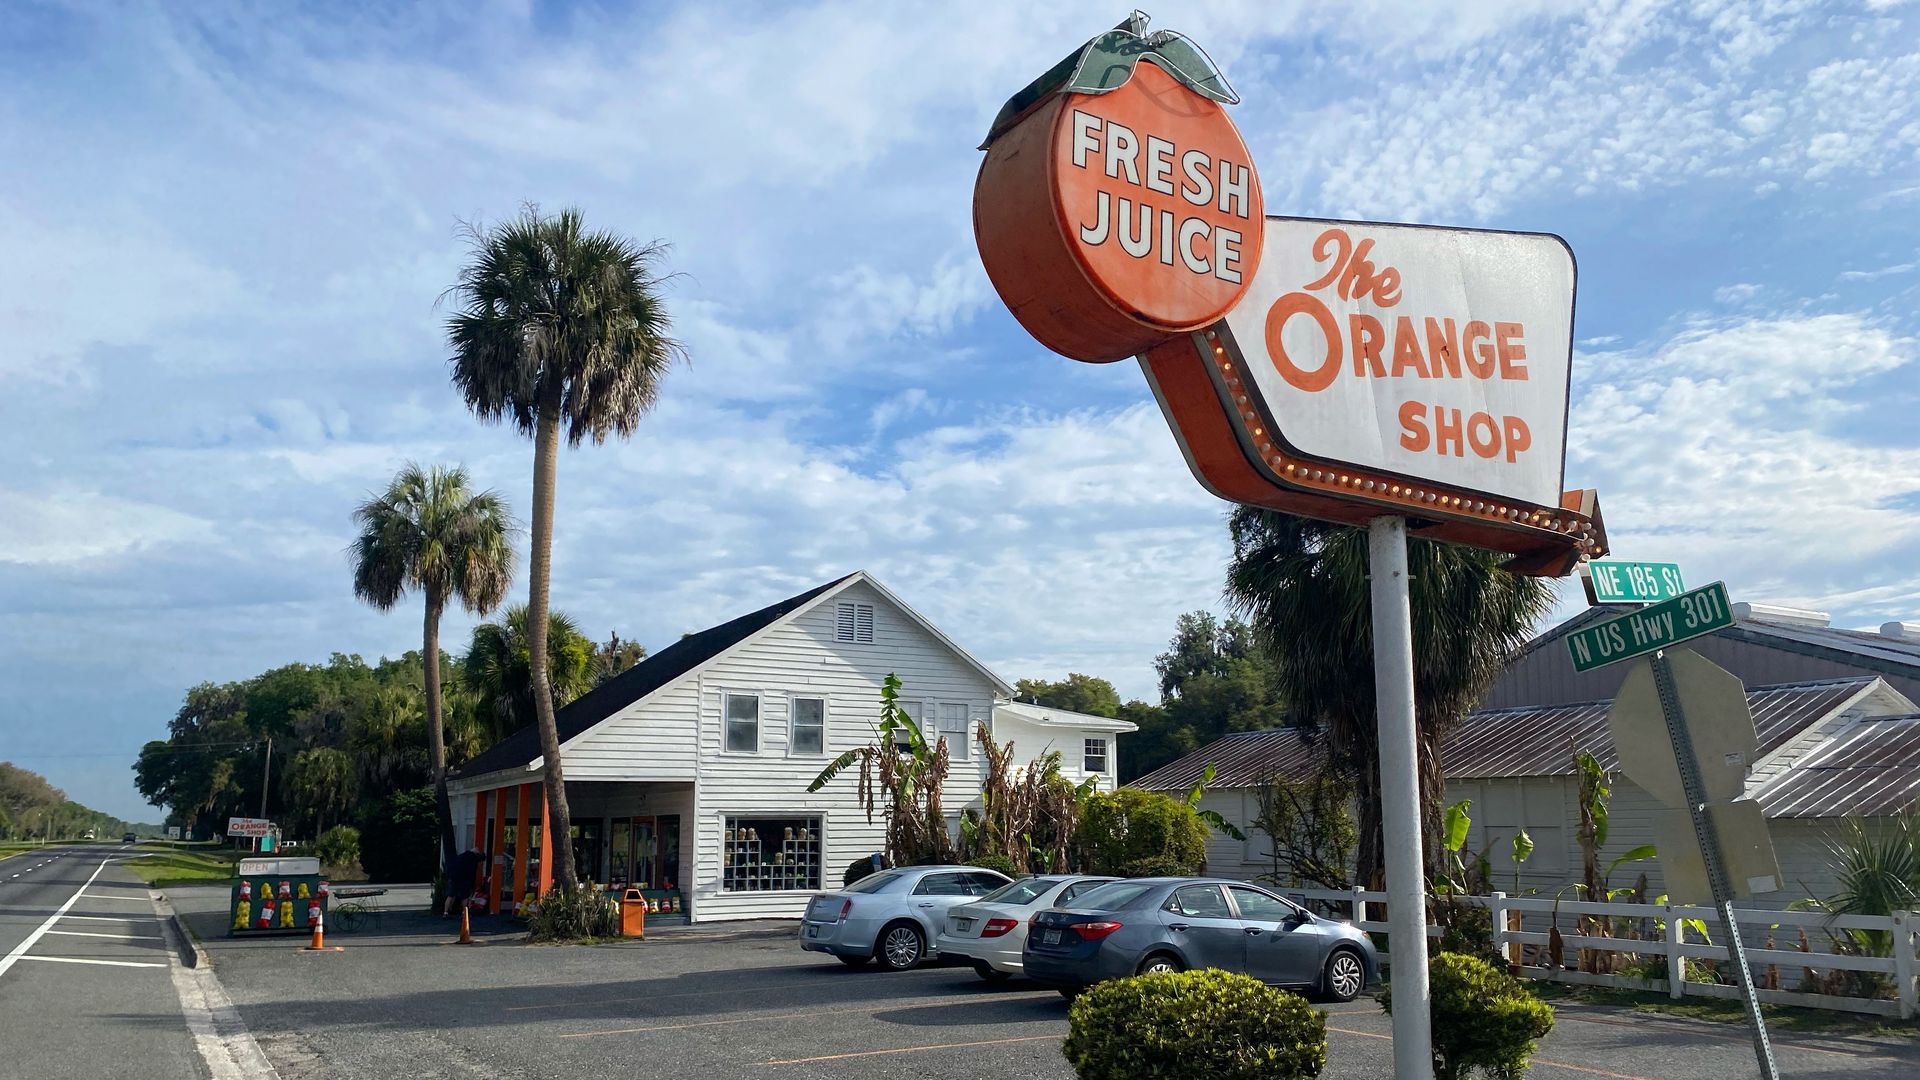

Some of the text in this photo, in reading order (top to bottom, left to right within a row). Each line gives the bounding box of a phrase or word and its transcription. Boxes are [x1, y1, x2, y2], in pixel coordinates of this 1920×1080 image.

[1072, 109, 1249, 220] FRESH
[1080, 189, 1242, 285] JUICE
[1302, 228, 1403, 308] The
[1265, 292, 1529, 392] ORANGE
[1398, 400, 1531, 463] SHOP
[1595, 566, 1682, 597] NE 185 St
[1573, 588, 1723, 665] N US Hwy 301
[242, 863, 269, 872] OPEN
